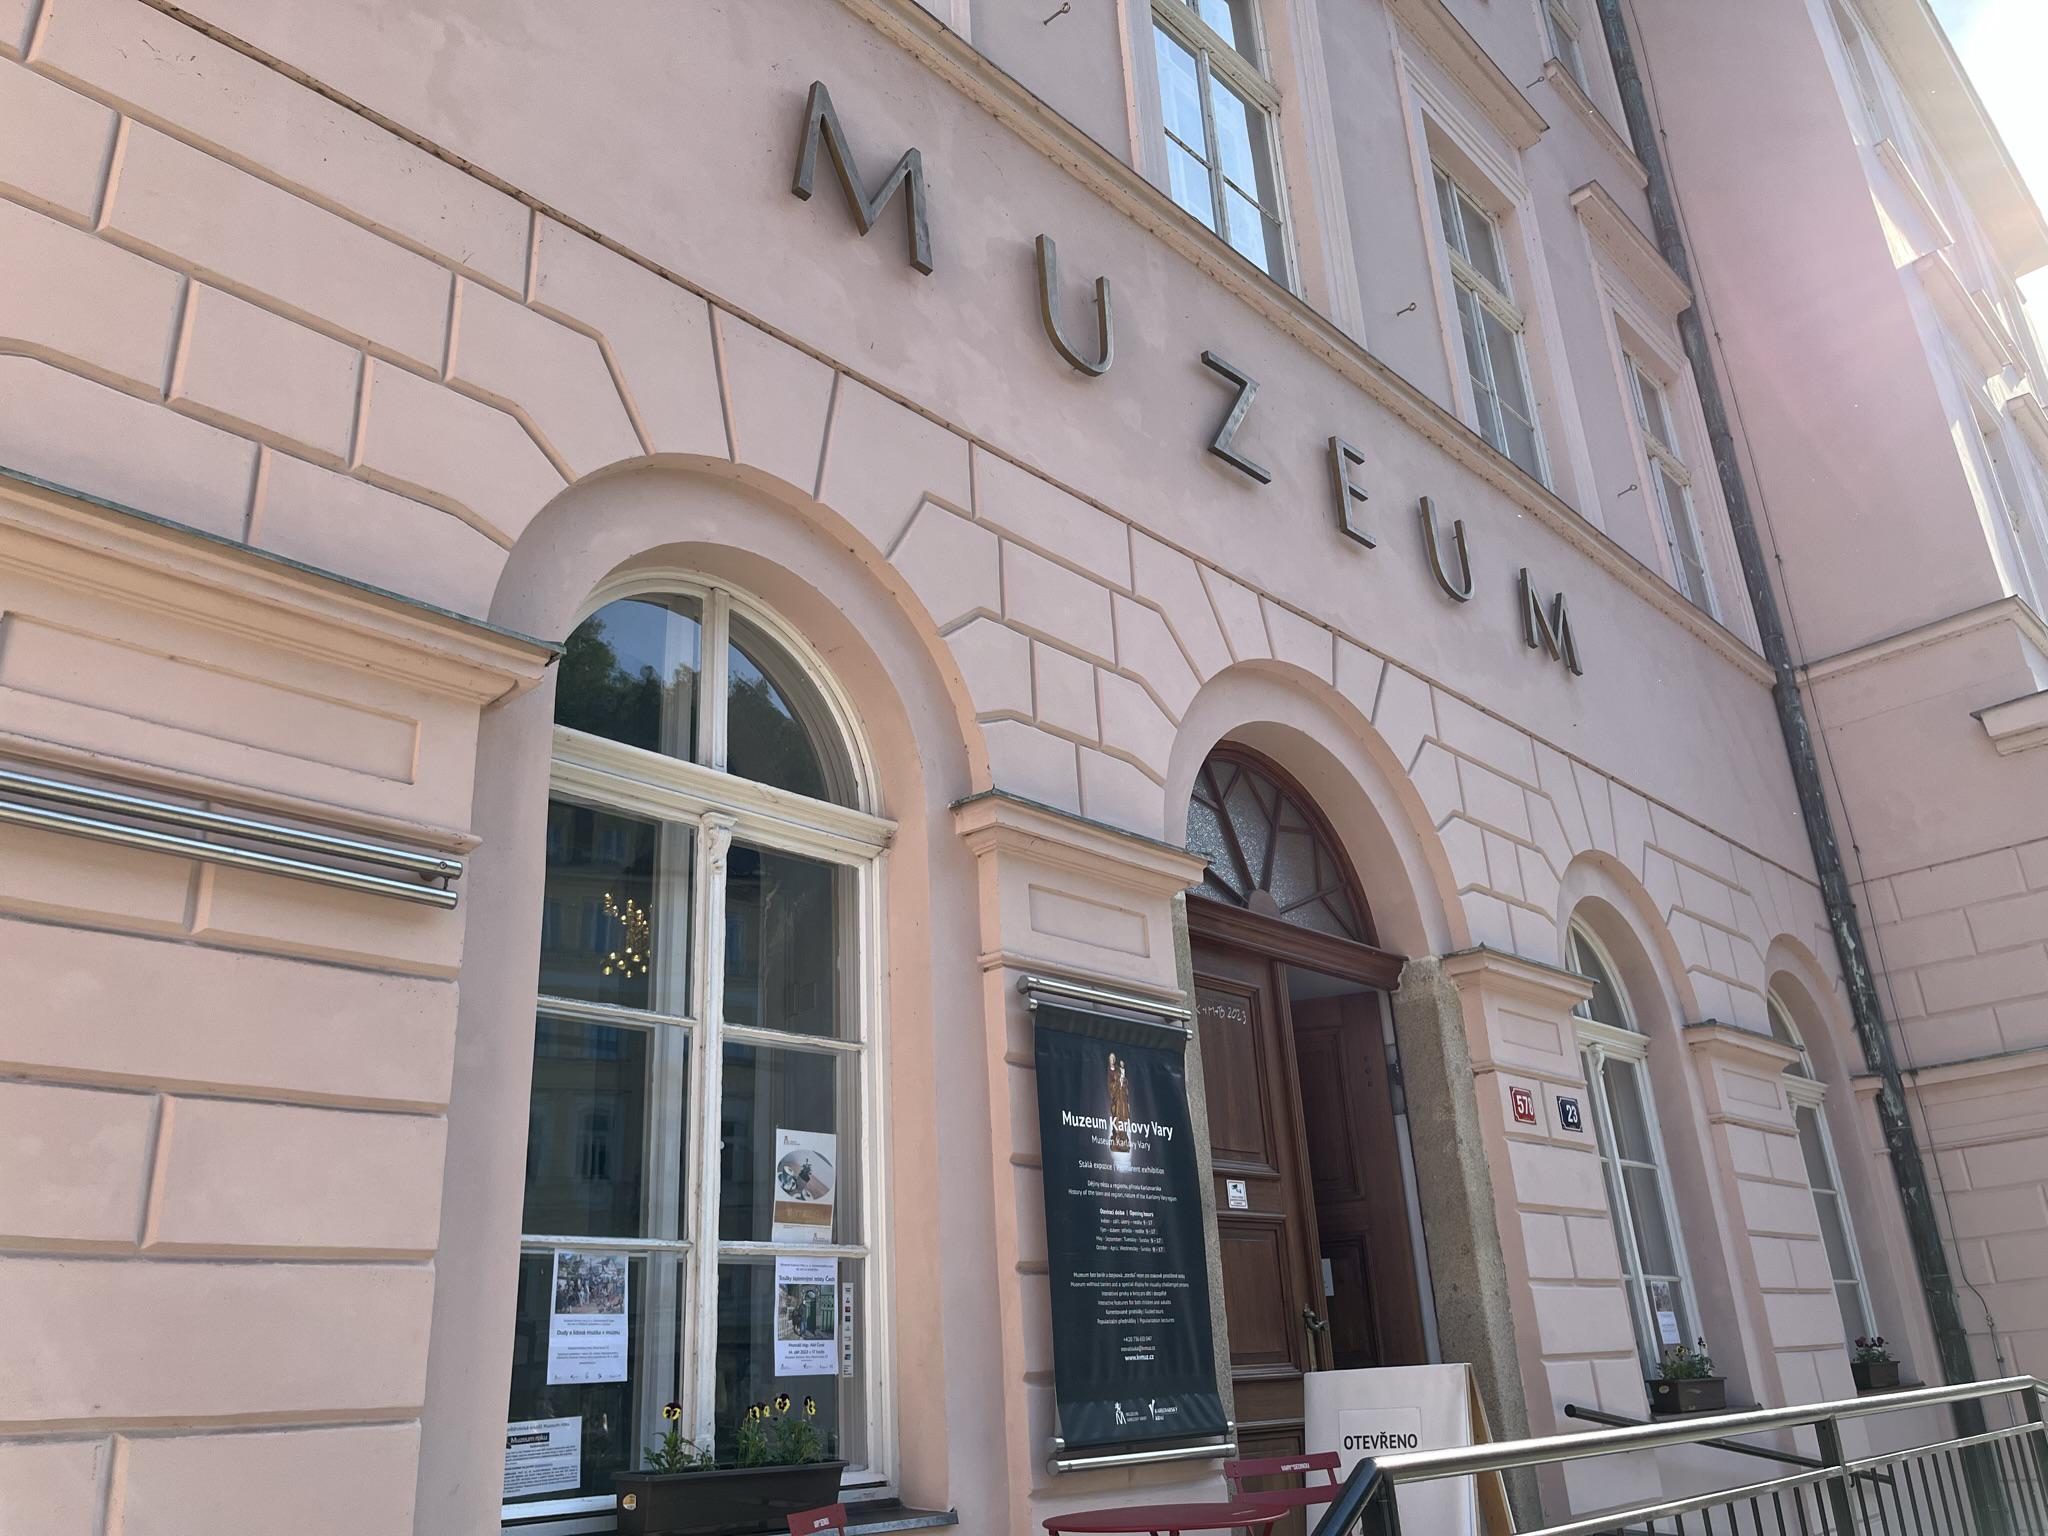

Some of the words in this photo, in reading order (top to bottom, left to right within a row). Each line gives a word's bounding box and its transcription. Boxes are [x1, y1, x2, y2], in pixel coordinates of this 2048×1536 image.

[792, 80, 1583, 676] MUZEUM
[1227, 1006, 1246, 1024] 2023
[1566, 1105, 1578, 1123] 23
[1062, 1110, 1108, 1130] Muzeum
[1109, 1116, 1150, 1138] Karlovy
[1151, 1121, 1173, 1141] Vary
[1137, 1141, 1150, 1151] Vary
[1344, 1432, 1418, 1450] OTEVŘENO
